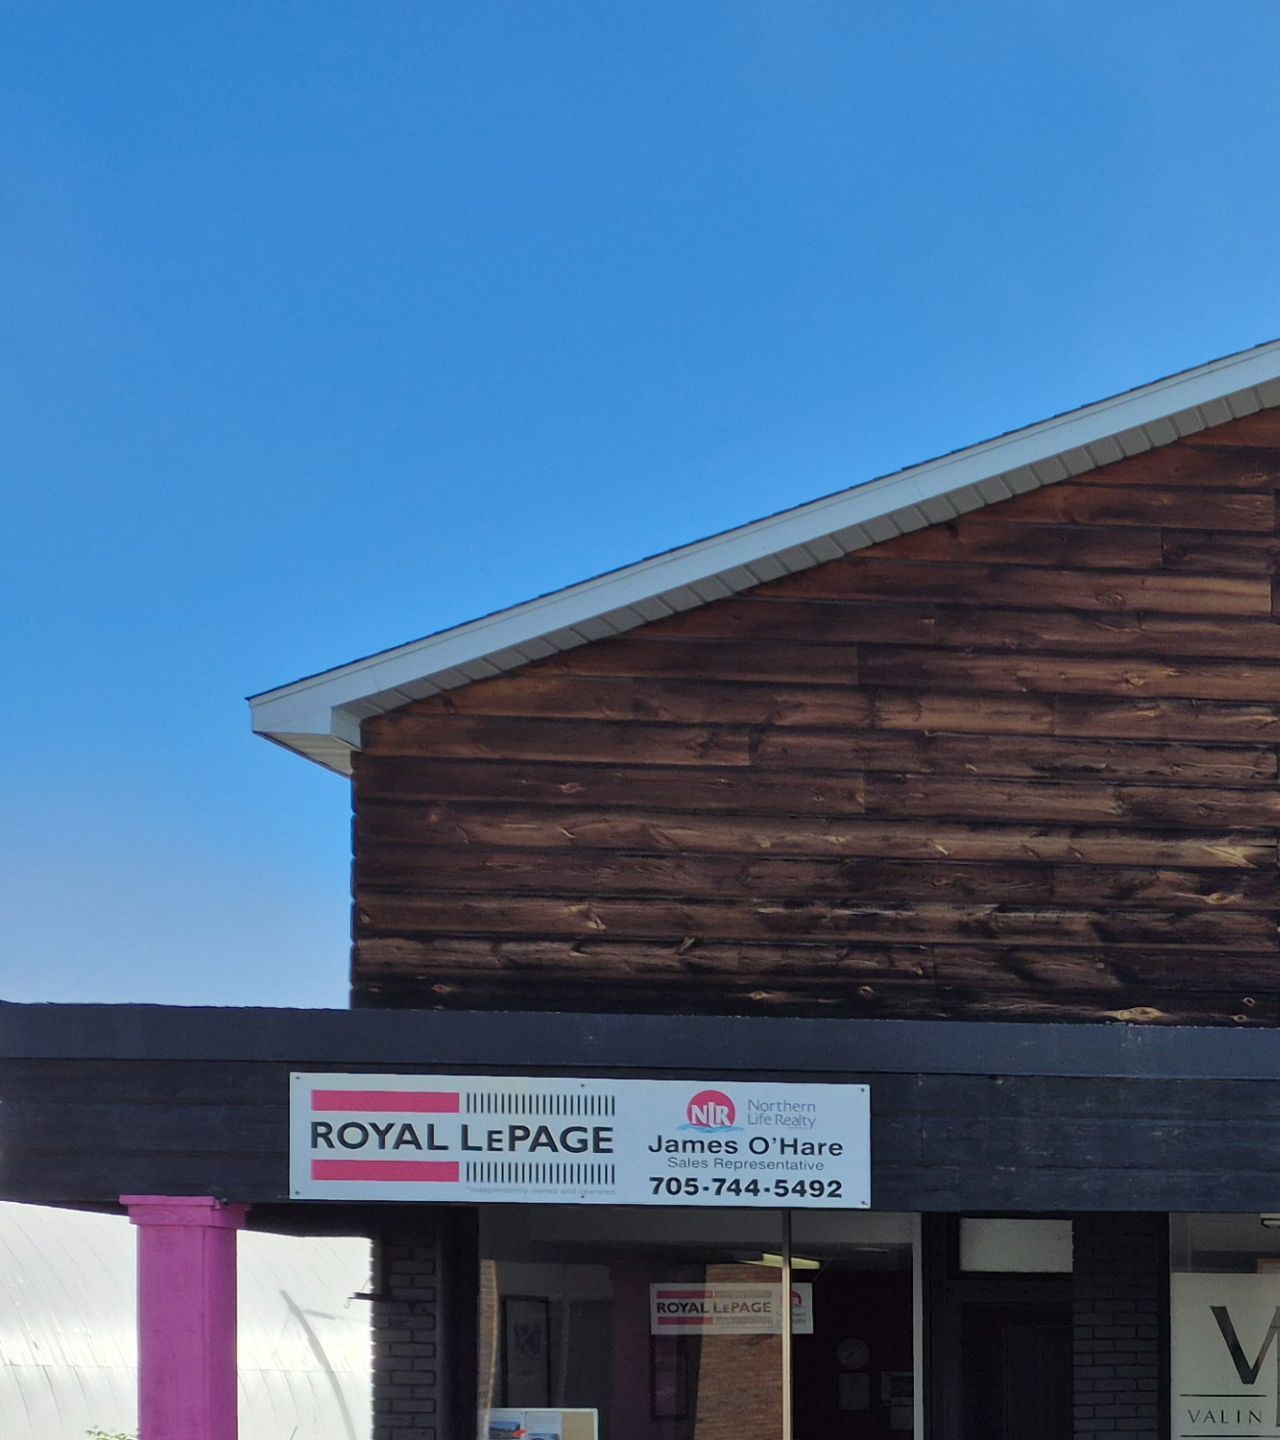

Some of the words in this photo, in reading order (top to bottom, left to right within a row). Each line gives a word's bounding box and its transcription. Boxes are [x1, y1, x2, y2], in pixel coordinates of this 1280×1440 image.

[747, 1099, 816, 1113] Northern
[747, 1114, 772, 1126] Life
[775, 1115, 816, 1130] Realty
[310, 1121, 449, 1151] ROYAL
[648, 1135, 739, 1154] James
[749, 1136, 844, 1157] O'Hare
[667, 1157, 709, 1169] Sales
[714, 1157, 825, 1172] Representative
[649, 1176, 843, 1199] 705-744-5492
[656, 1301, 710, 1314] ROYAL
[1187, 1408, 1263, 1425] VALIN
